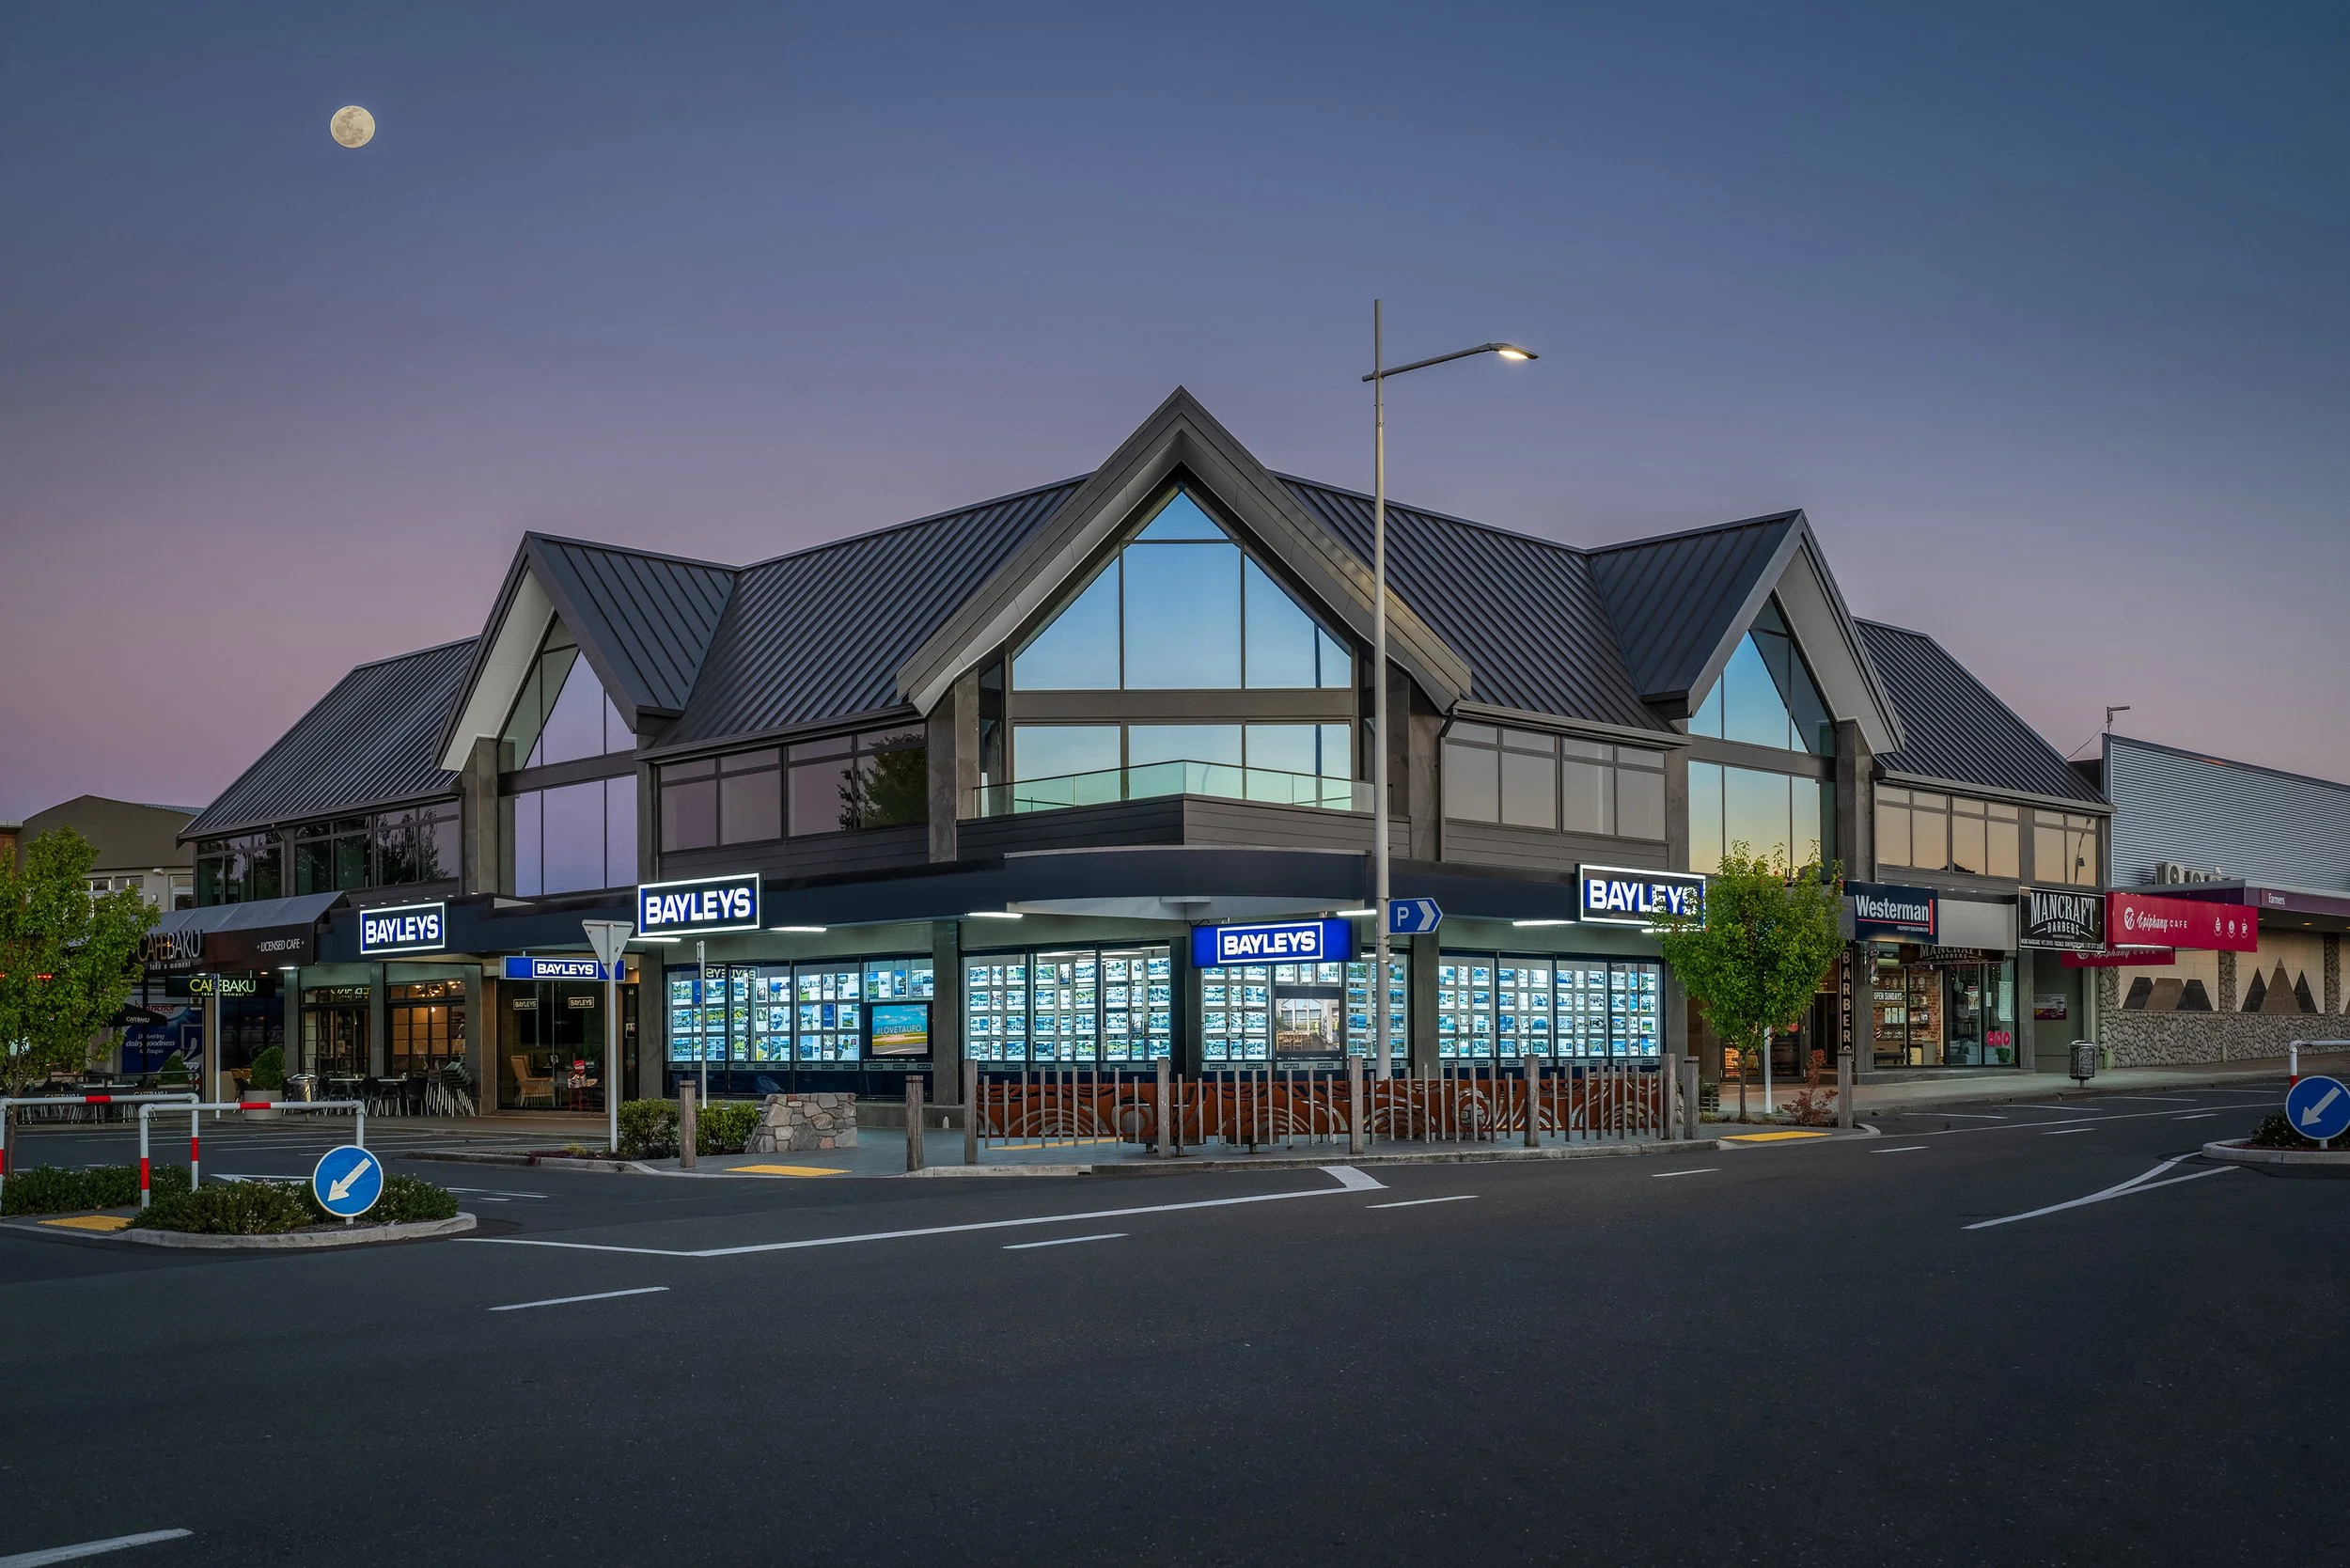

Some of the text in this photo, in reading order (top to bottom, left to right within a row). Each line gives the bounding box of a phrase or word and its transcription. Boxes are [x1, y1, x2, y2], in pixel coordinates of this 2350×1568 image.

[646, 886, 751, 924] BAYLEYS
[1590, 879, 1698, 916] BAYLEYS
[1855, 894, 1929, 921] Westerman
[2268, 892, 2285, 905] Farmers
[1397, 906, 1409, 927] P
[2030, 892, 2096, 932] MANCRAFT
[2137, 910, 2187, 933] Epiphany CAFE
[365, 914, 439, 945] BAYLEYS
[2047, 921, 2080, 935] BARBERS
[137, 930, 201, 962] CAFEBAKU
[260, 938, 300, 952] LICENSED CAFE
[1223, 930, 1316, 956] BAYLEYS
[150, 962, 162, 971] take
[169, 961, 191, 969] moment
[537, 963, 594, 975] BAYLEYS
[570, 998, 593, 1007] BAYLEYS
[1873, 992, 1903, 1001] OPEN SUNDAYS
